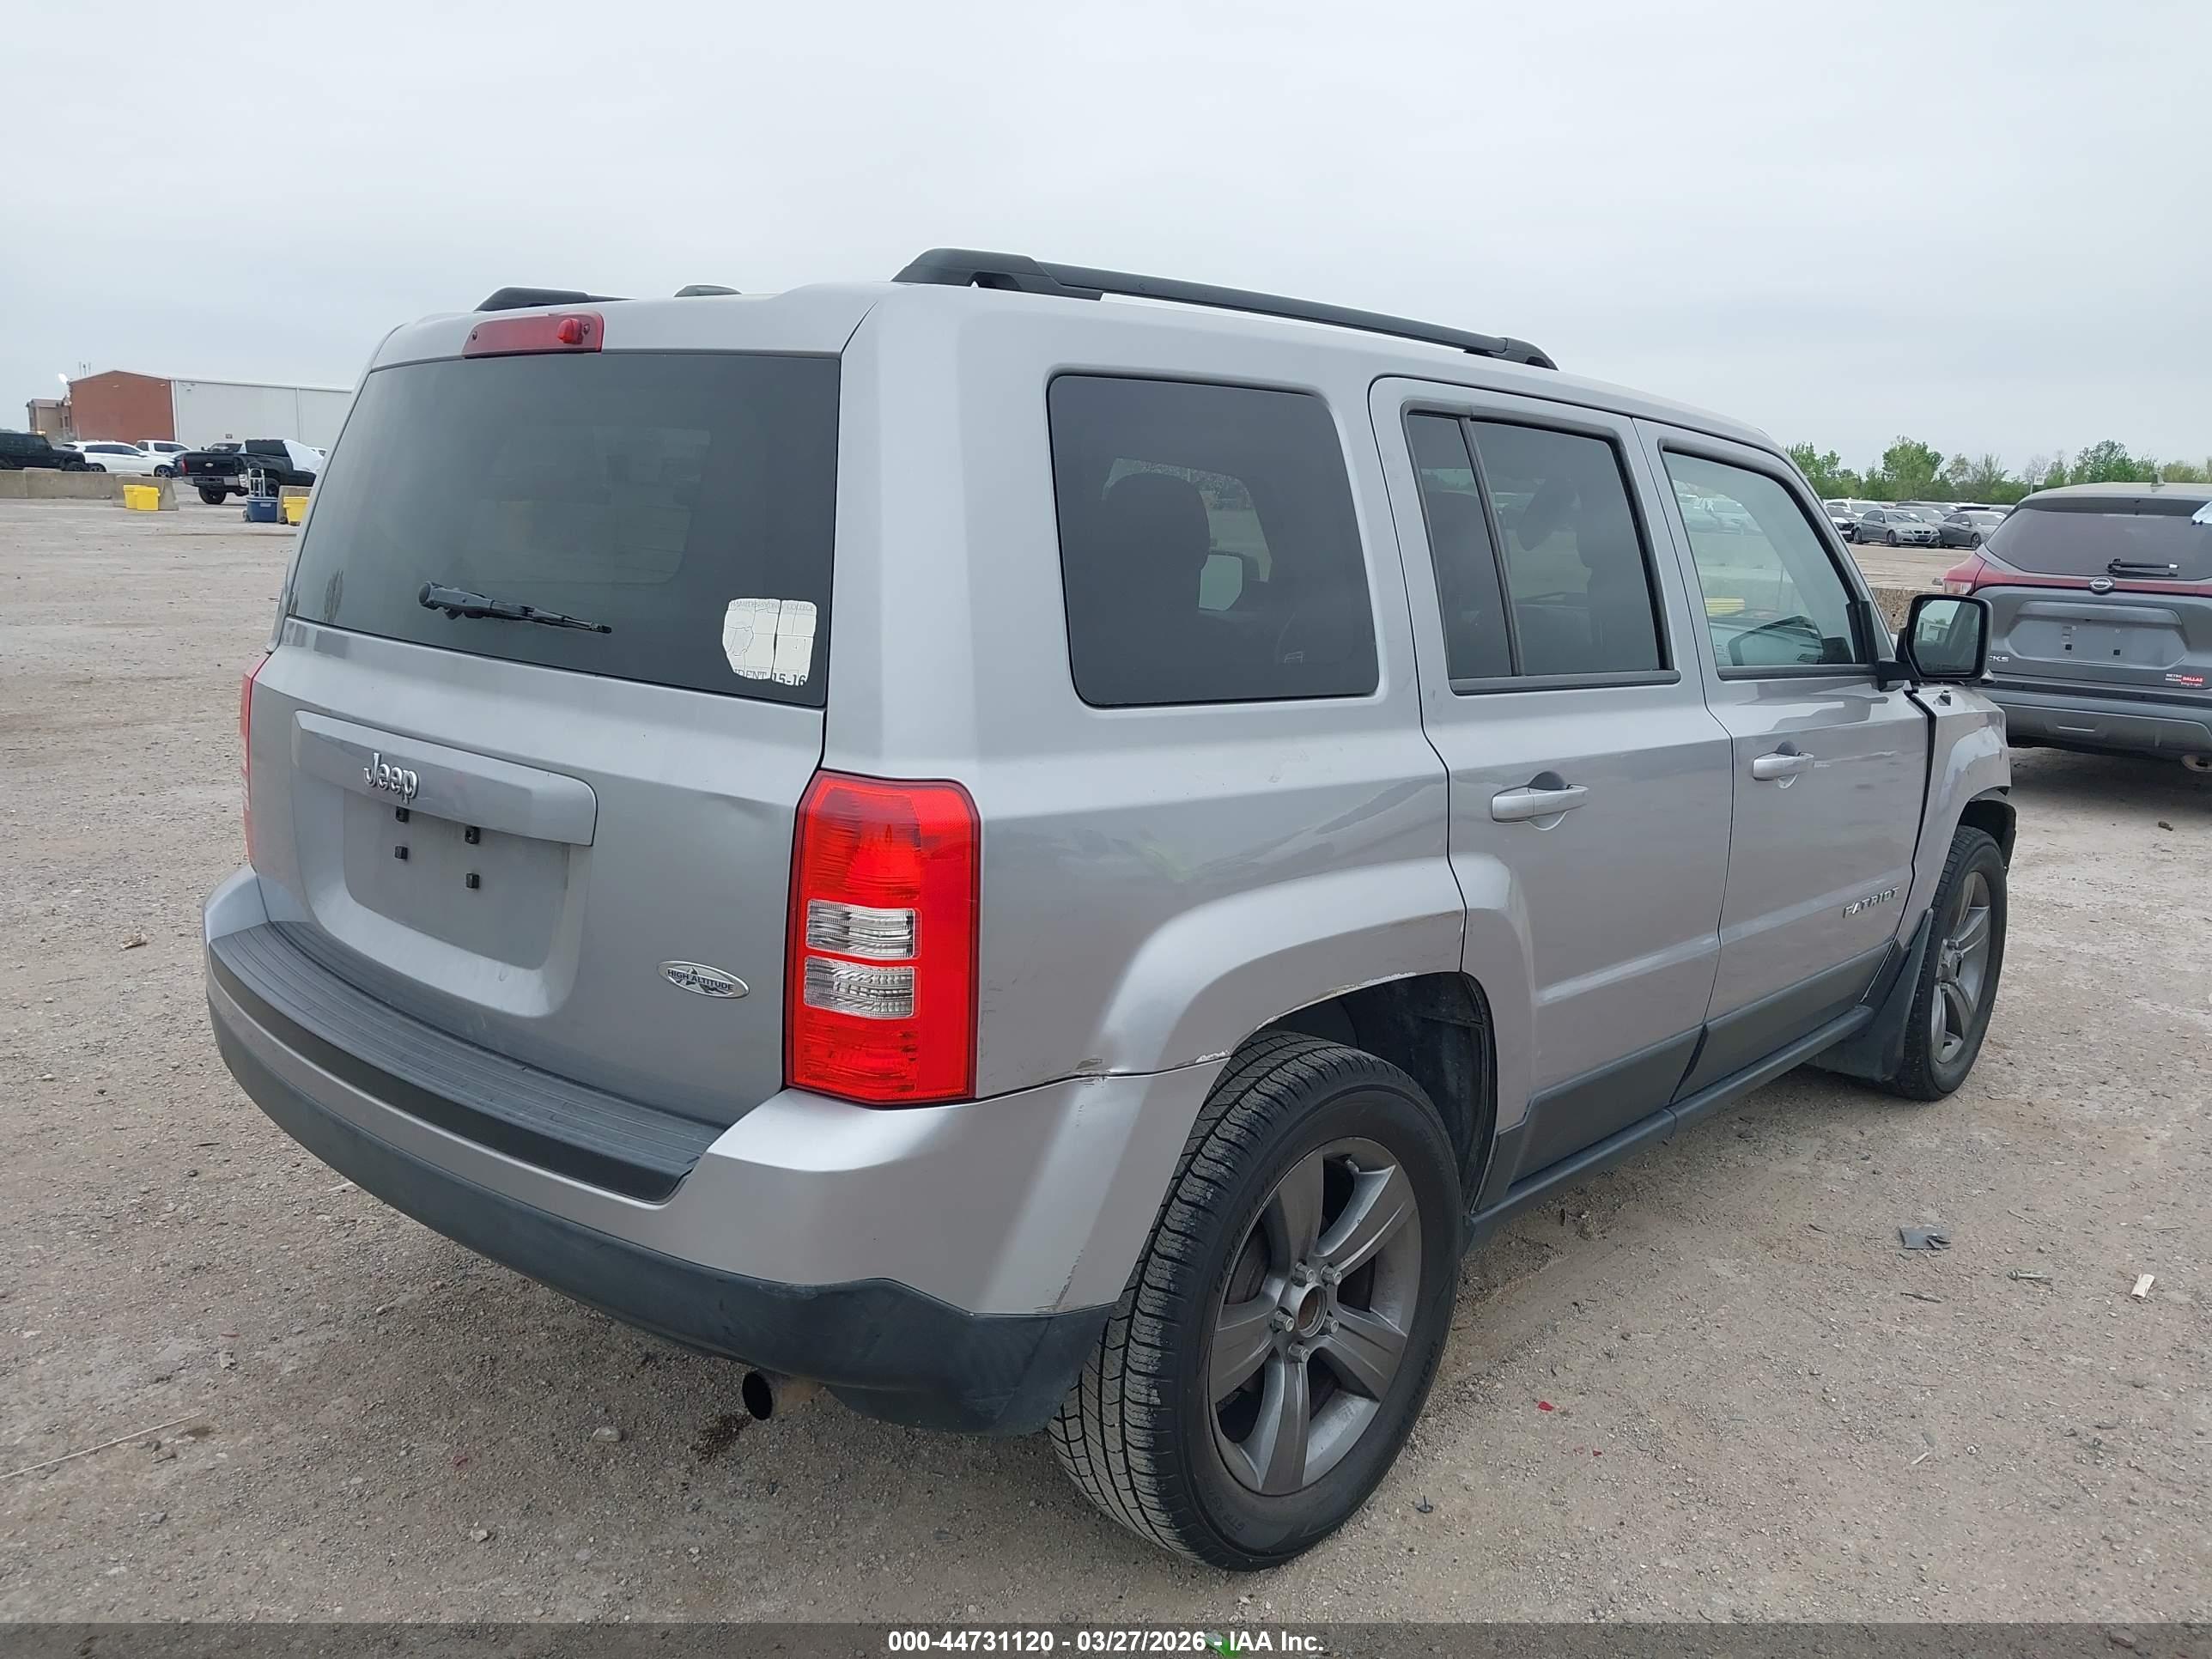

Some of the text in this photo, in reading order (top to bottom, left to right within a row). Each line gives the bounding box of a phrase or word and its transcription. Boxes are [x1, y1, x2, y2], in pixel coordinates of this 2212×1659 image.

[363, 752, 419, 805] Jeep
[1843, 885, 1899, 919] PATRIOT
[667, 969, 733, 991] HIGH ALTITUDE
